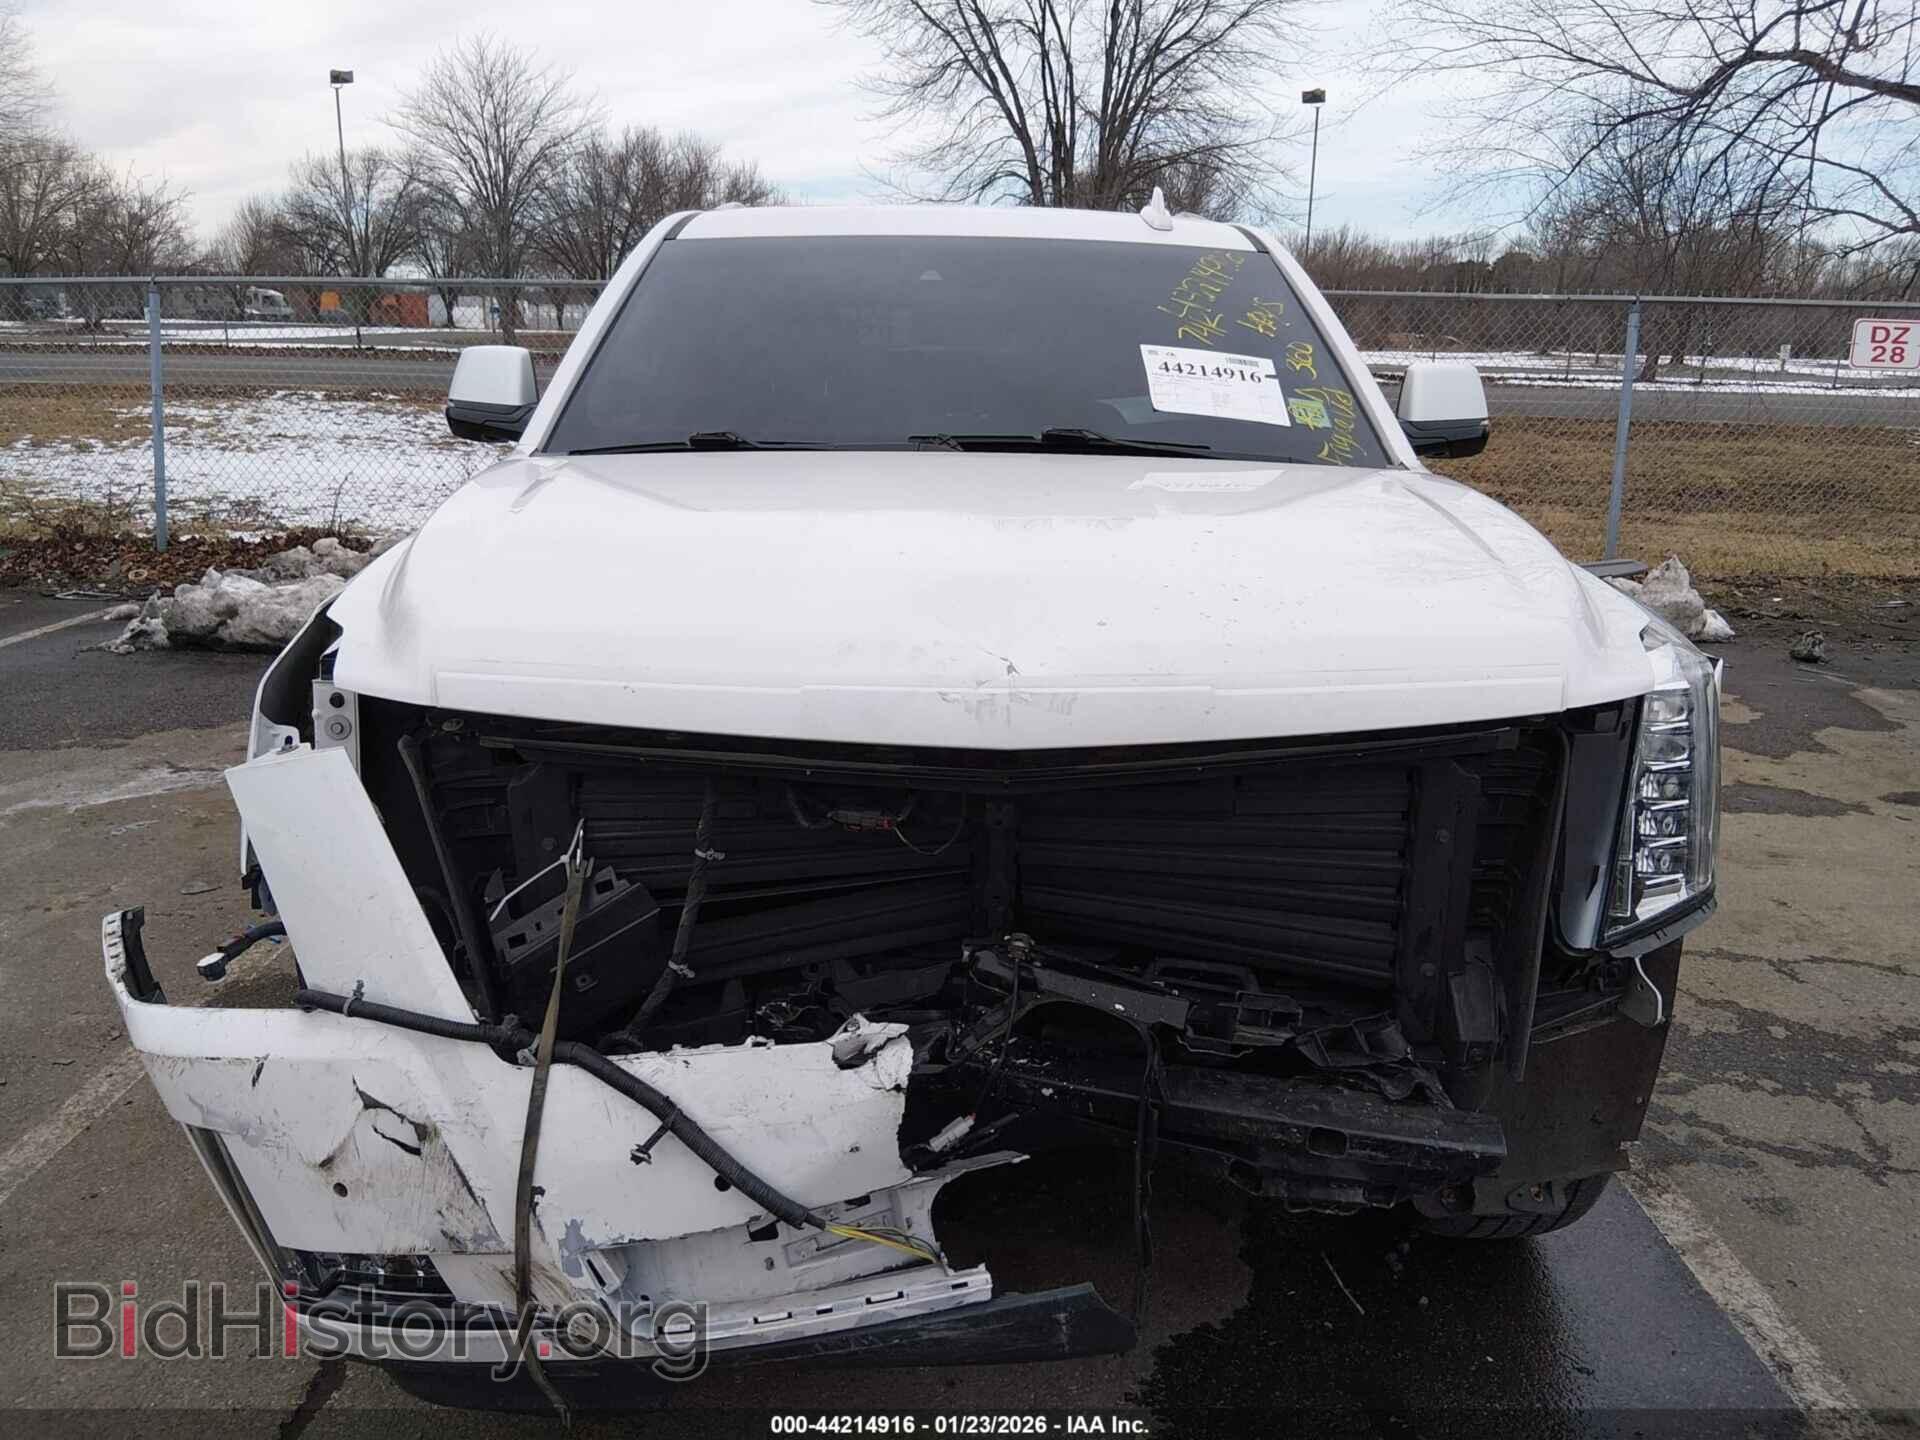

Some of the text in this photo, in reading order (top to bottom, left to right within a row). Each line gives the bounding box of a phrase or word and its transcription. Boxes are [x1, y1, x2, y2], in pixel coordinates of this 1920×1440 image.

[1870, 326, 1911, 345] DZ
[1870, 345, 1905, 363] 28
[1158, 360, 1262, 384] 44214916
